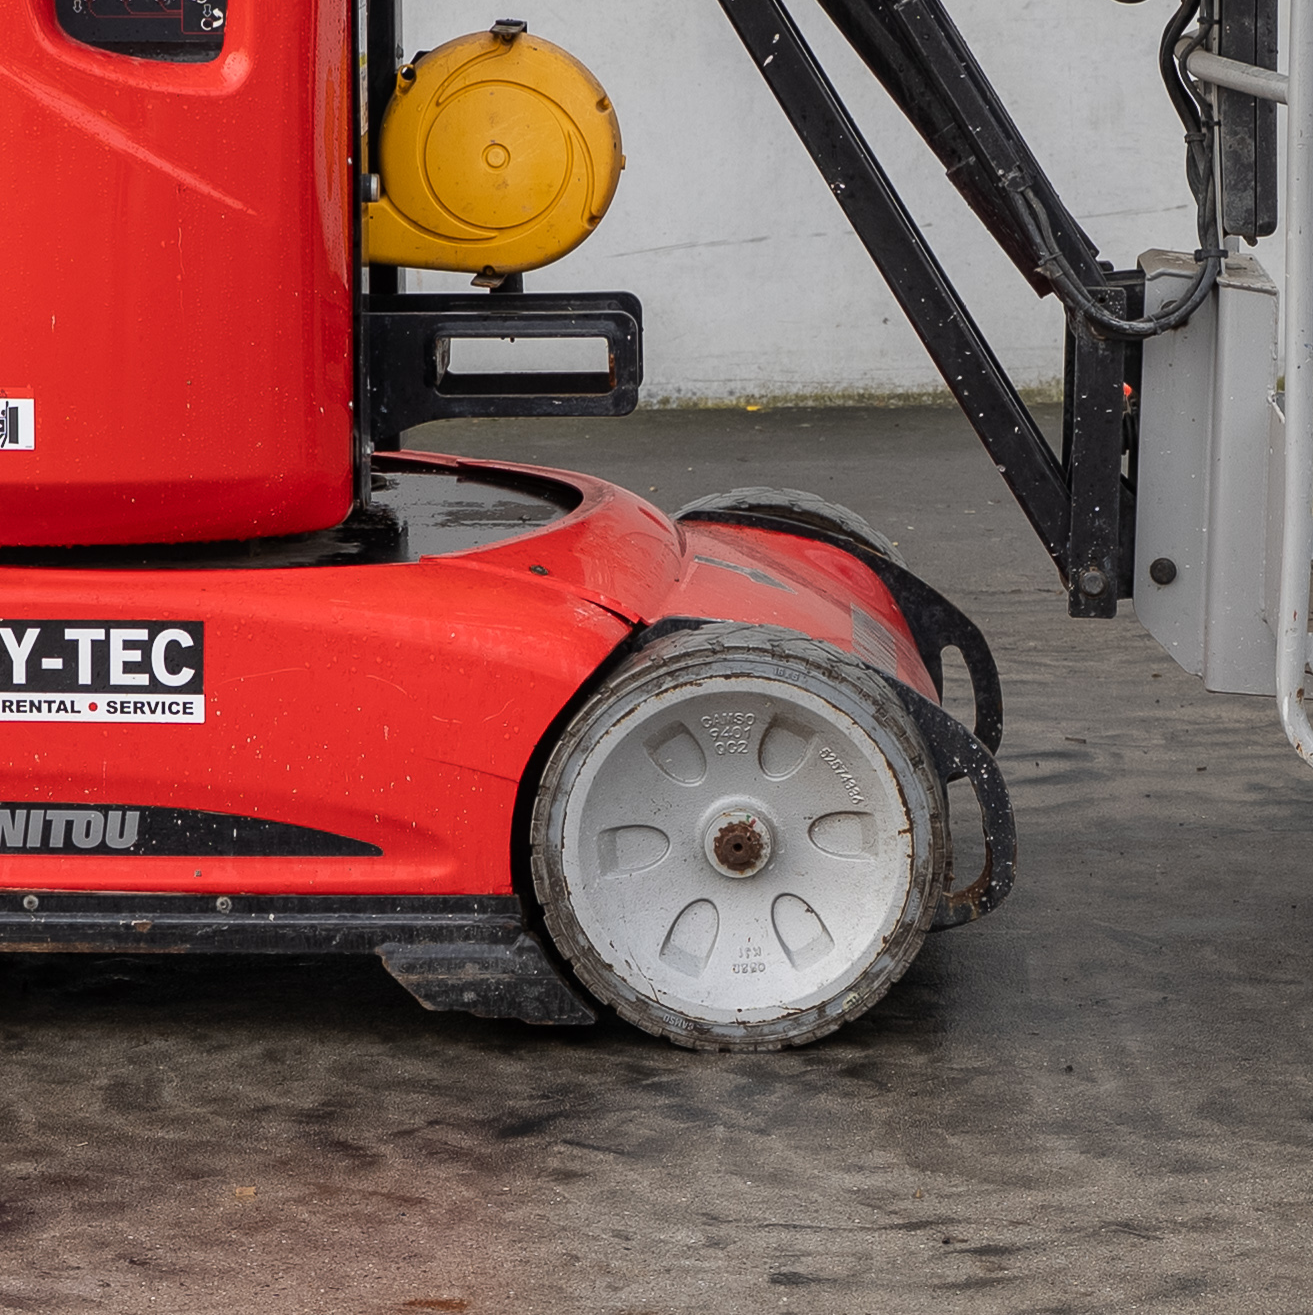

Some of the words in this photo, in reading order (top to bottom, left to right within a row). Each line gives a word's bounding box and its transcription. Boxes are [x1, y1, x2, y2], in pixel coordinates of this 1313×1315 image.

[1, 699, 82, 714] RENTAL
[105, 700, 194, 715] SERVICE
[700, 712, 756, 728] CAMSO
